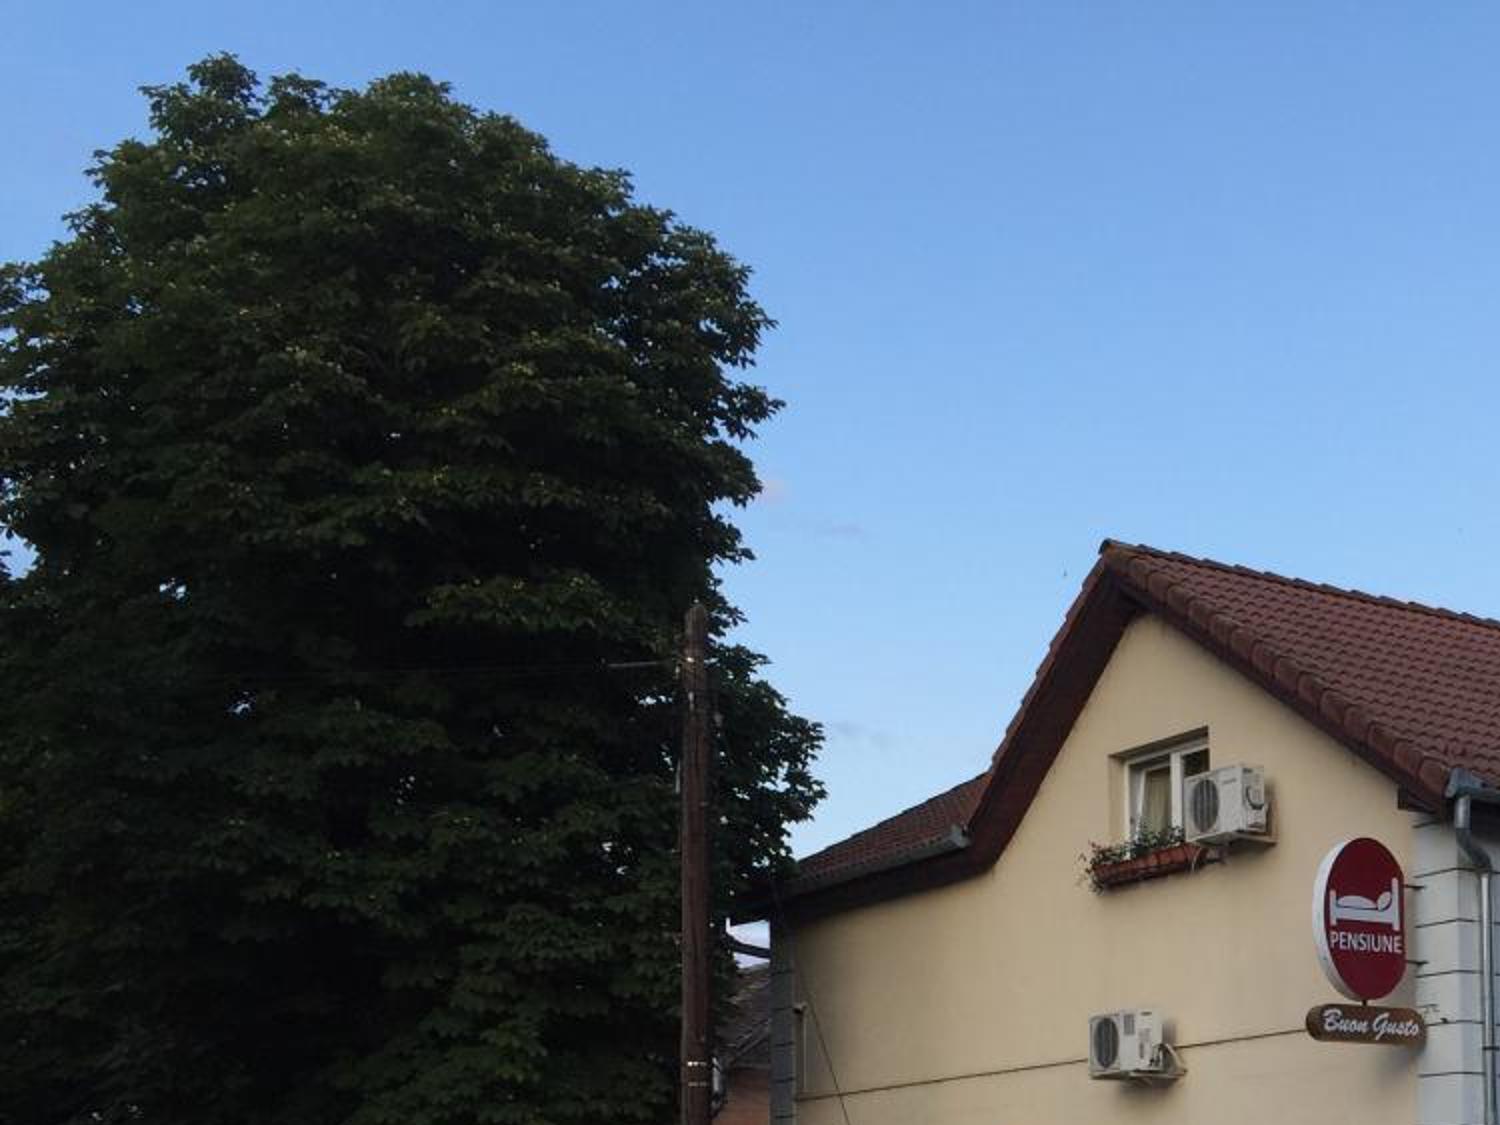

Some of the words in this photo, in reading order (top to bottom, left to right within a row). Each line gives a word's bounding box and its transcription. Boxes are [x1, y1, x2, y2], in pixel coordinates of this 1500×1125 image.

[1330, 931, 1403, 954] PENSIUNE
[1323, 1008, 1369, 1033] Buon
[1373, 1012, 1419, 1041] Gusto
